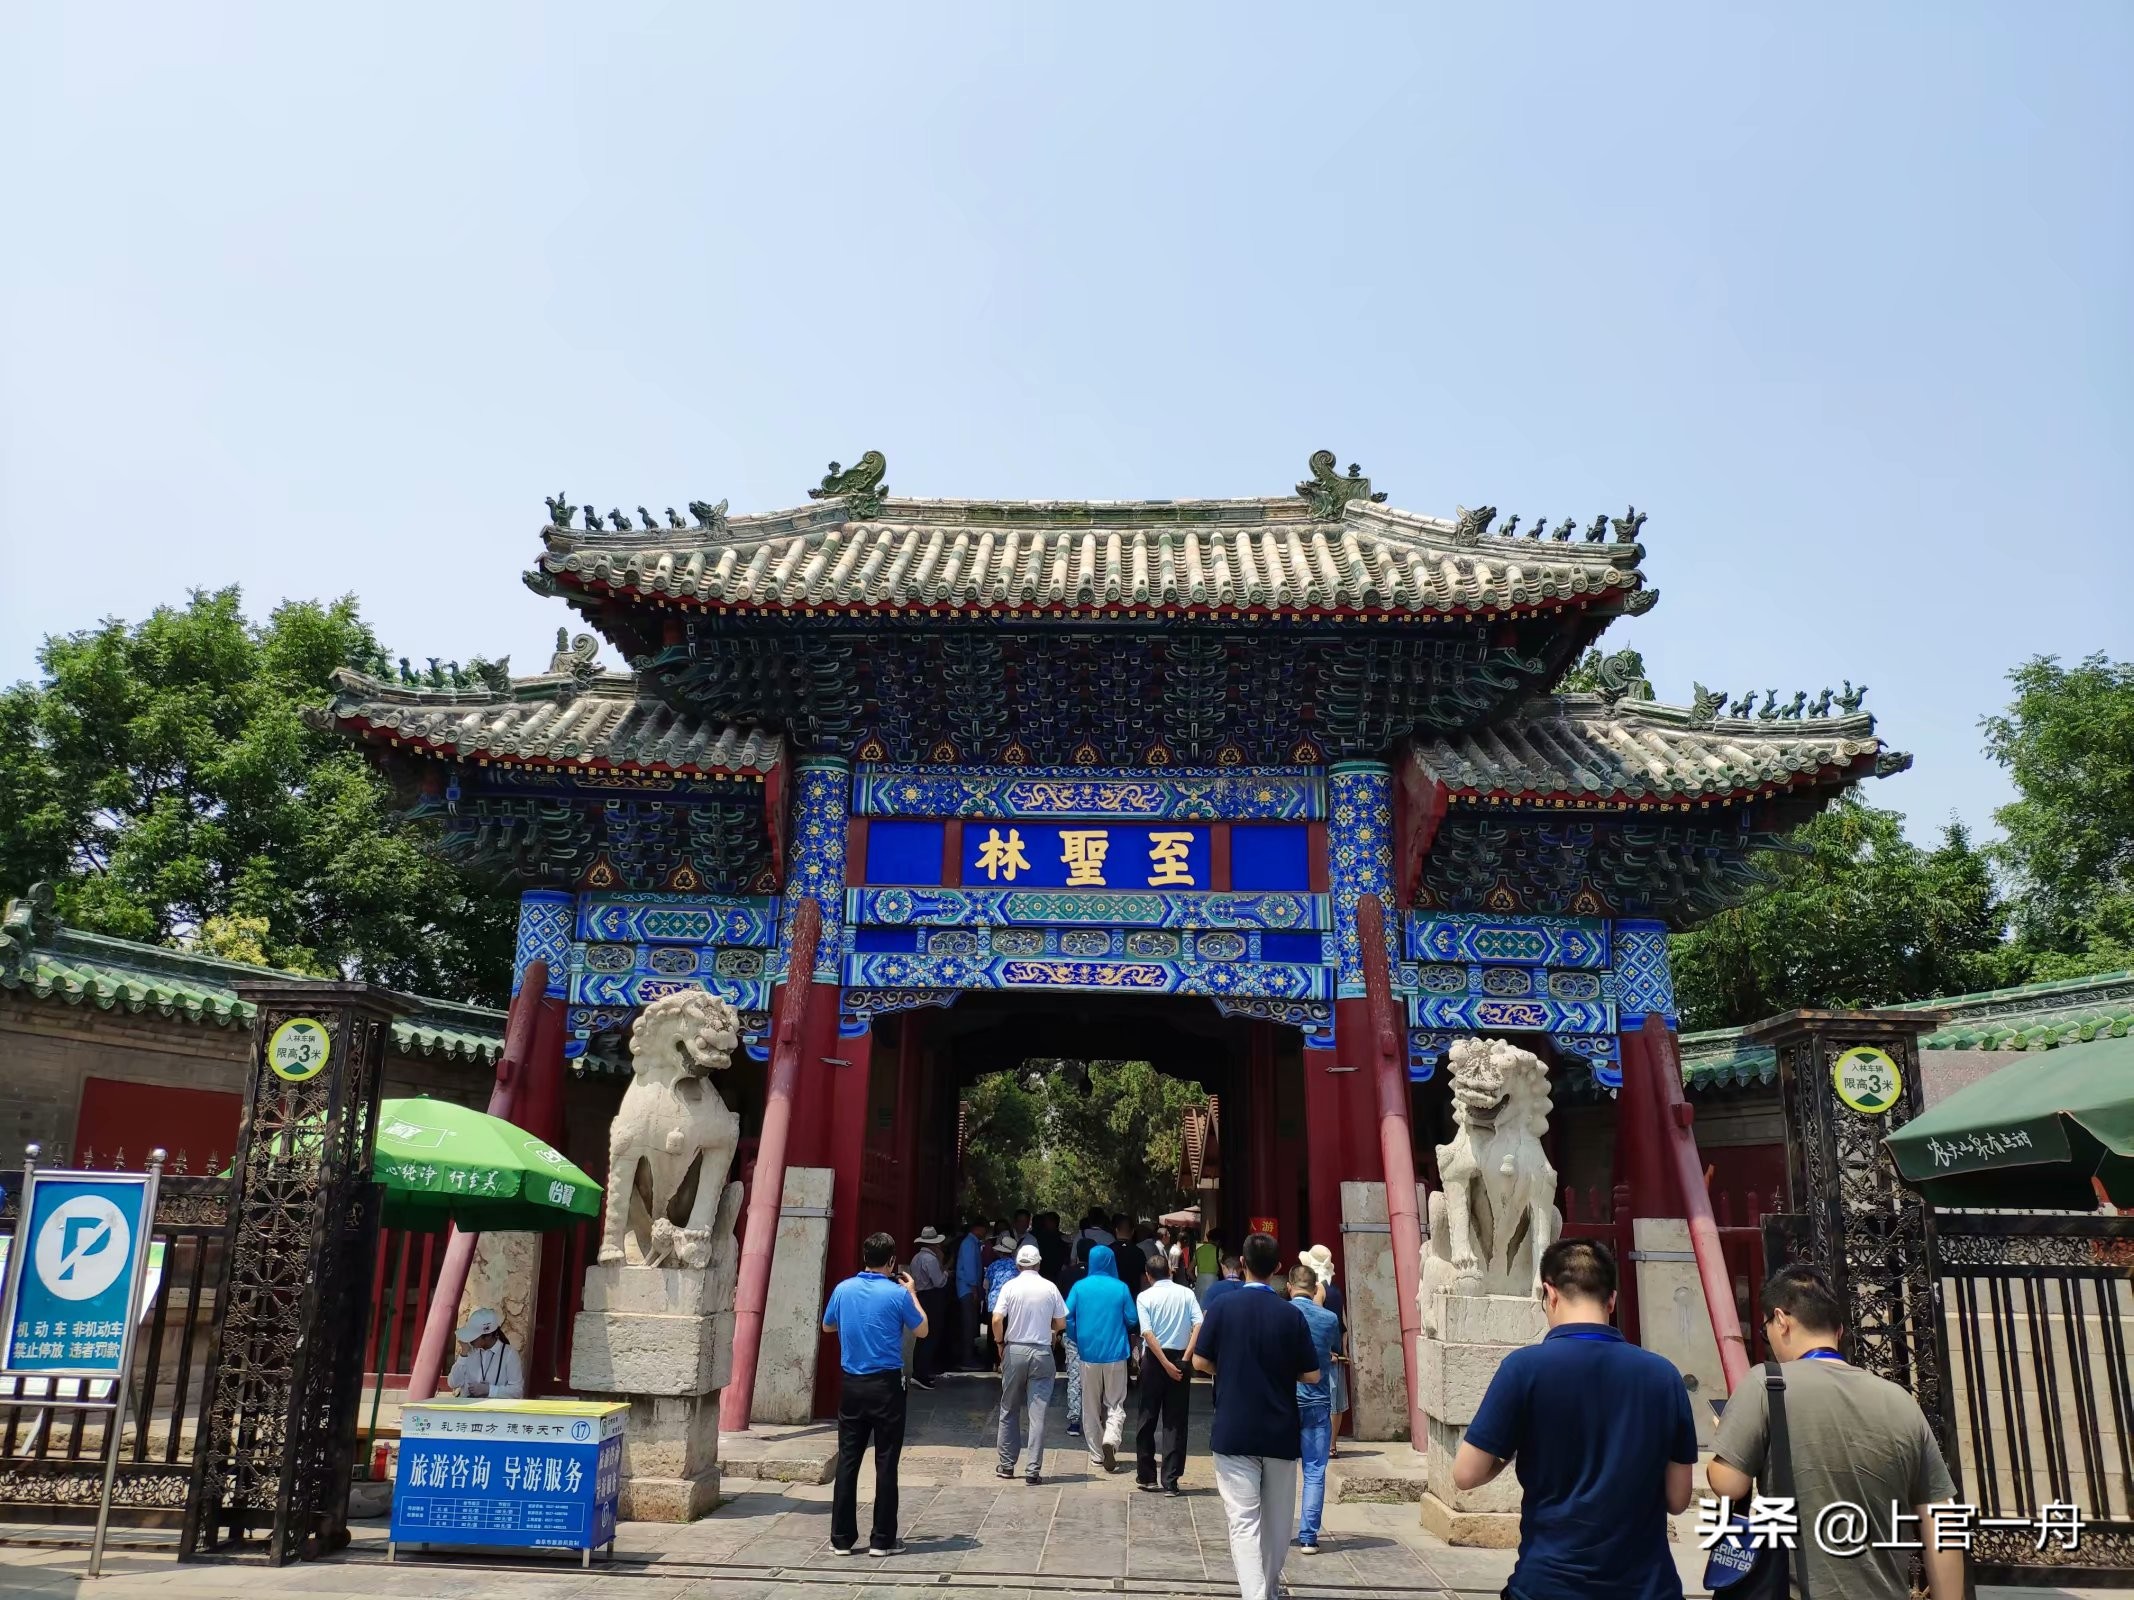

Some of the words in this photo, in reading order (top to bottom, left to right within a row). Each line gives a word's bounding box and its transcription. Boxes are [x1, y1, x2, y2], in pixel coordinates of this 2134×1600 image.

[286, 1034, 316, 1042] 入林车辆
[276, 1044, 322, 1062] 限高3米
[1851, 1063, 1884, 1073] 入林车辆
[1844, 1074, 1894, 1093] 限高3米
[15, 1321, 67, 1338] 机动车
[72, 1321, 123, 1338] 非机动车
[13, 1341, 64, 1359] 禁止停放
[69, 1341, 120, 1359] 违者罚款
[408, 1453, 491, 1490] 旅游咨询
[502, 1456, 583, 1493] 导游服务
[1712, 1553, 1752, 1573] RISTER
